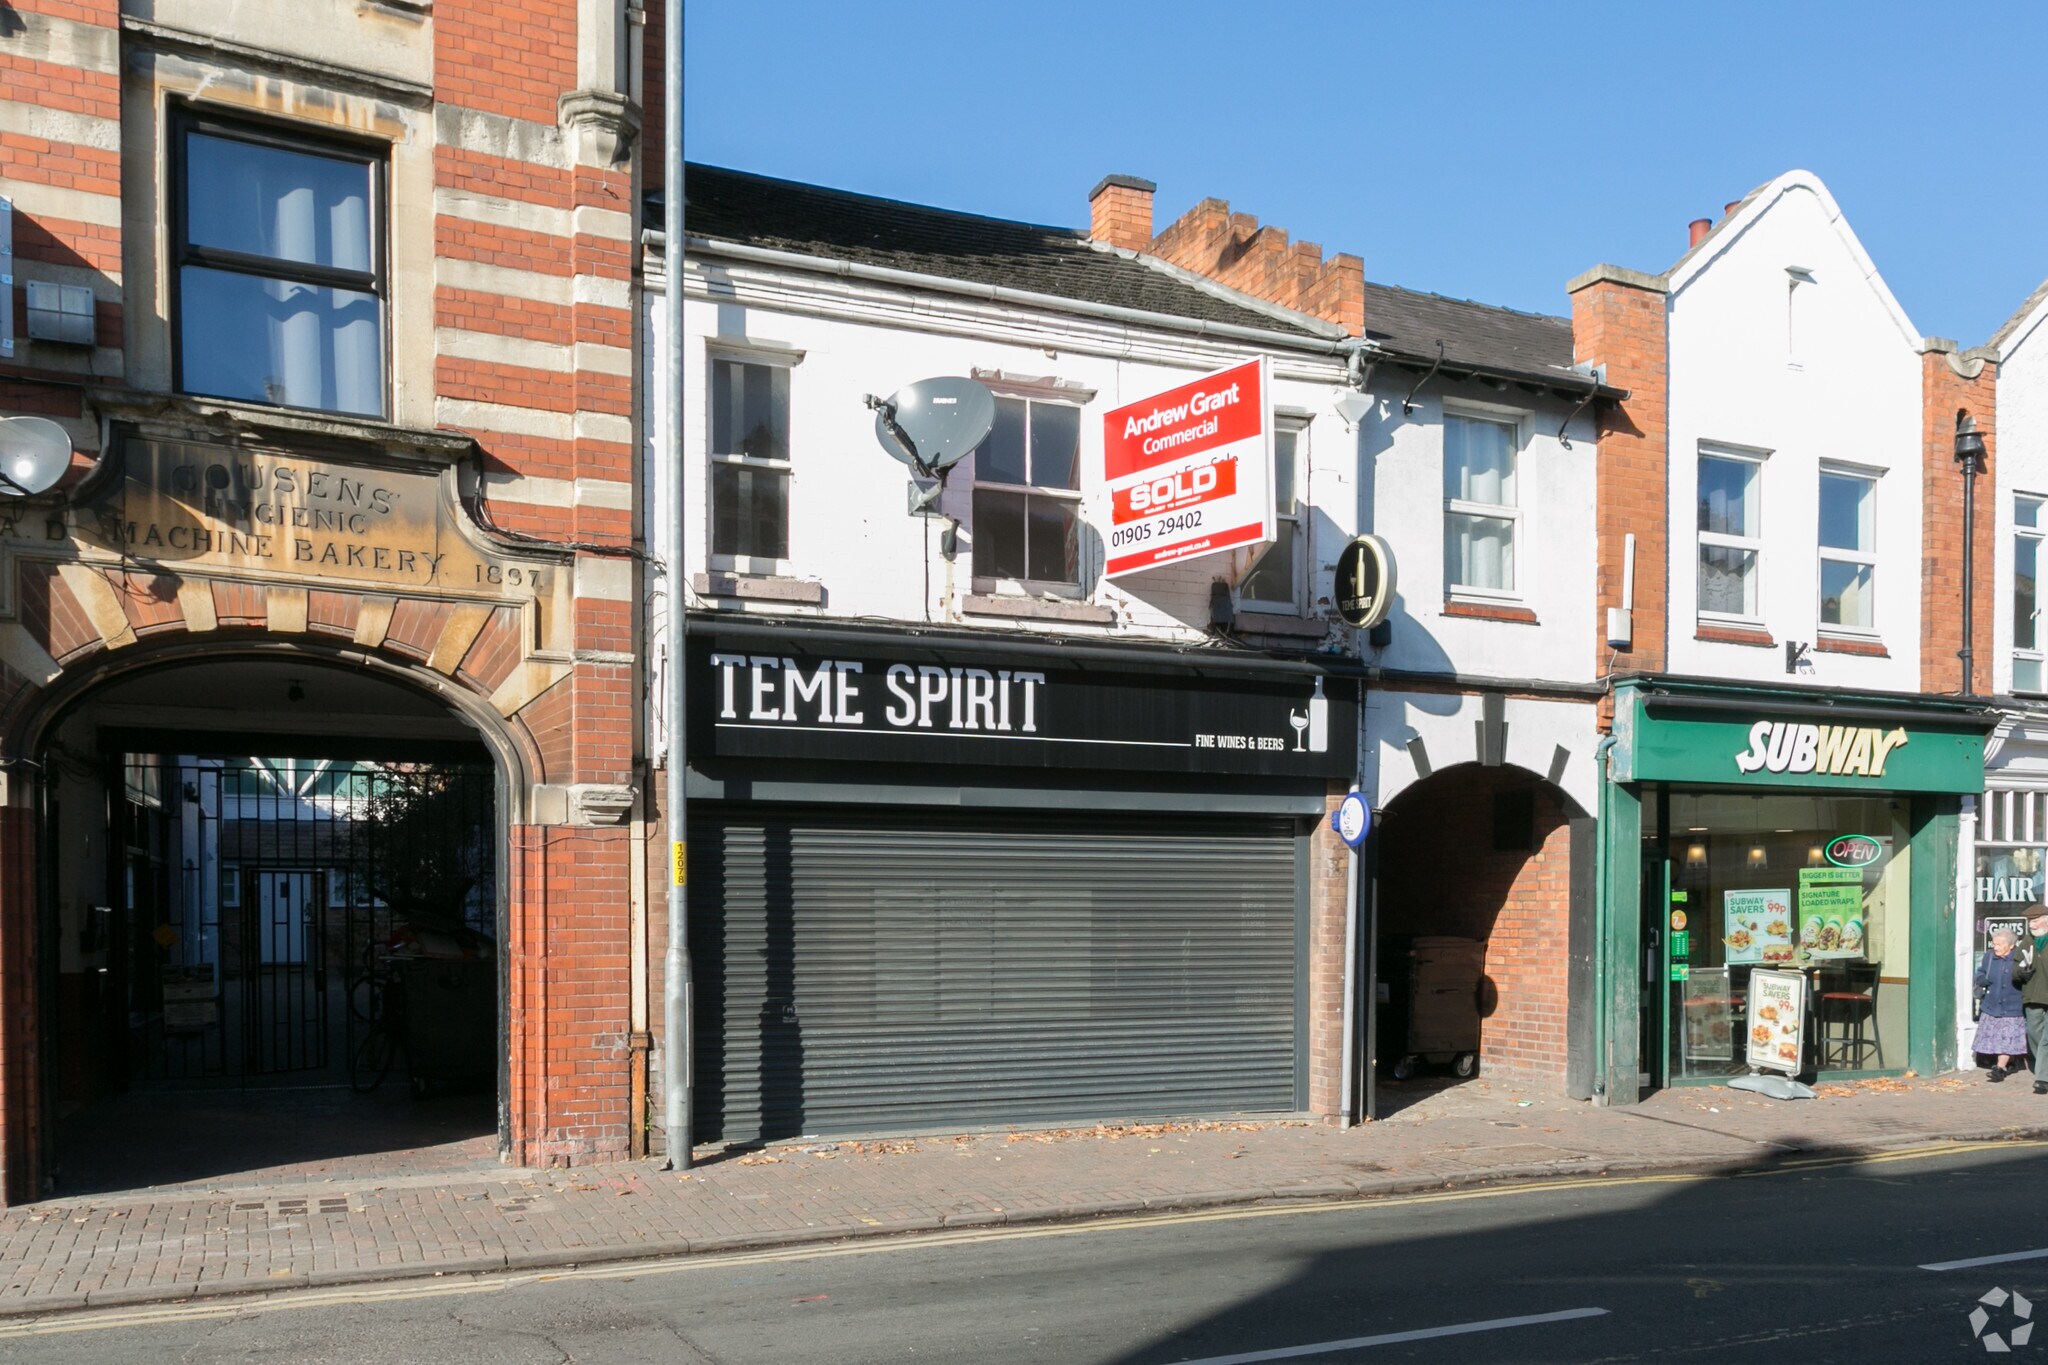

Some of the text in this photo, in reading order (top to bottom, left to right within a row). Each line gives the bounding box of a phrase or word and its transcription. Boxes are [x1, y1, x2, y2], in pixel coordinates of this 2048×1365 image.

[1123, 382, 1240, 440] Andrew Grant
[1142, 415, 1219, 456] Commercial
[1129, 464, 1217, 512] SOLD
[204, 496, 366, 535] HYGIENIC
[112, 518, 273, 558] MACHINE
[1111, 510, 1203, 548] 01905 29402
[711, 653, 1046, 733] TEME SPIRIT
[1195, 734, 1285, 751] FINE WINES & BEERS
[1735, 720, 1908, 777] SUBWAY
[1833, 841, 1875, 860] OPEN
[677, 843, 685, 884] 12078
[1802, 871, 1827, 879] BIGGER
[1801, 890, 1840, 898] SIGNATURE
[1975, 876, 2037, 902] HAIR
[1730, 897, 1764, 905] SUBWAY
[1730, 905, 1765, 914] SAVERS
[1767, 903, 1787, 915] 99p
[1762, 982, 1791, 992] SUBWAY
[1762, 990, 1791, 1000] SAVERS
[1778, 1000, 1795, 1012] 99p
